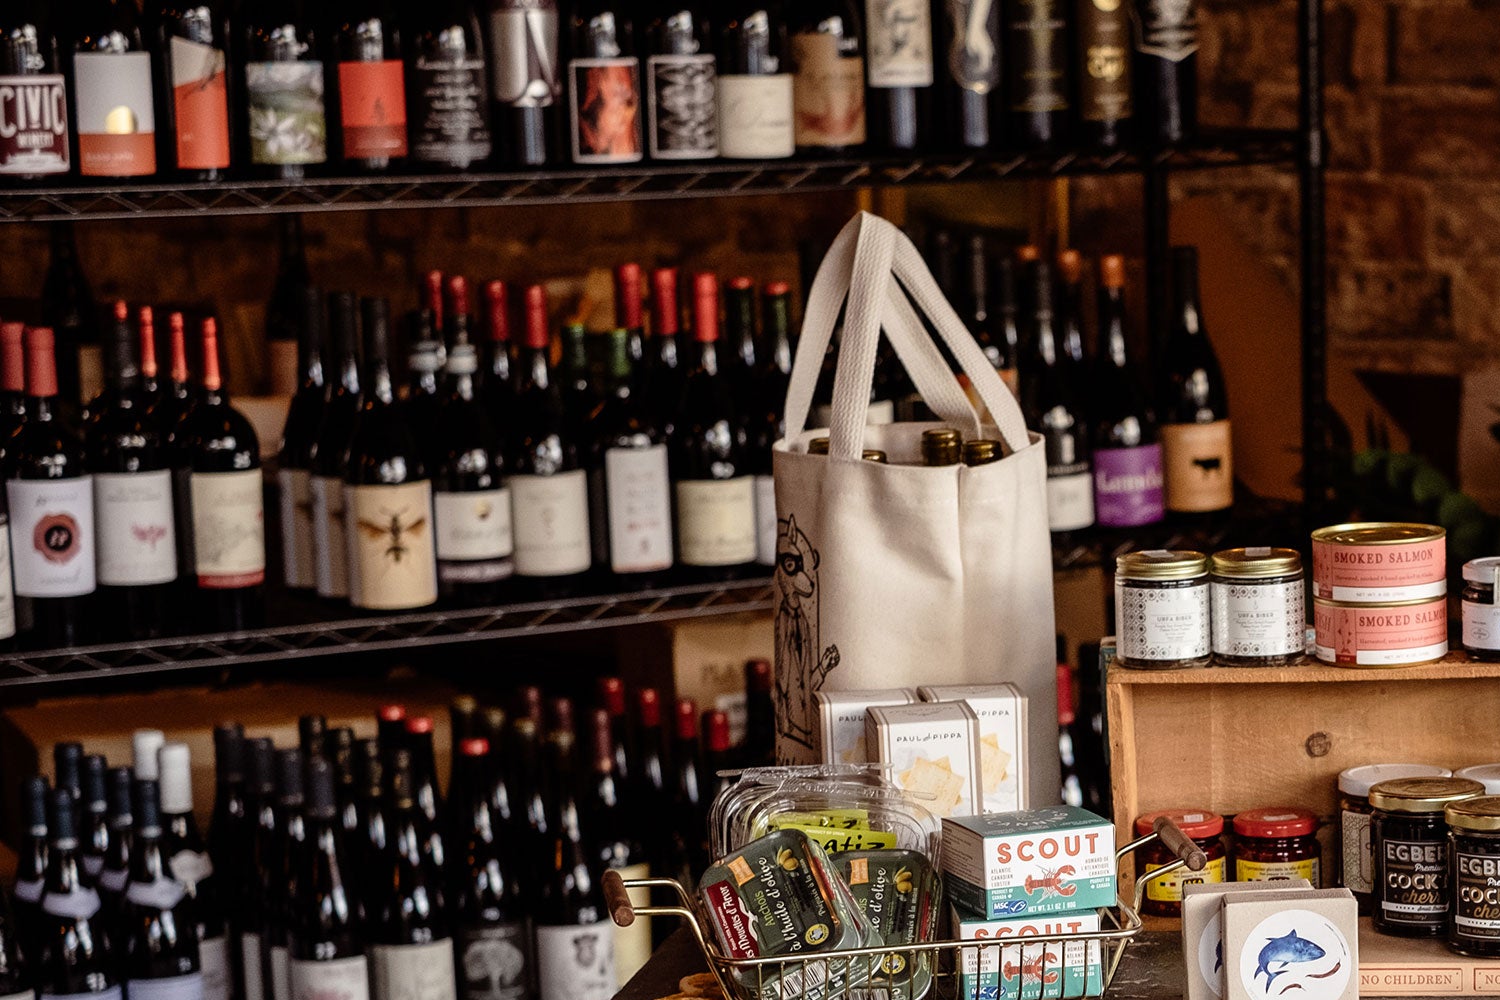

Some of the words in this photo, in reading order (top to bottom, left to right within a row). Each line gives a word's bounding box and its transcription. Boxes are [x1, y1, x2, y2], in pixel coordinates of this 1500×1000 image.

[0, 86, 66, 139] CIVIC
[1334, 552, 1383, 564] SMOKED
[1389, 549, 1433, 563] SALMON
[1359, 615, 1410, 627] SMOKED
[1415, 608, 1446, 620] SALMO
[838, 715, 864, 723] PAUL
[932, 732, 962, 740] PIPPA
[815, 834, 886, 851] atiz
[997, 833, 1098, 864] SCOUT
[758, 857, 781, 898] d'olive
[1387, 873, 1440, 891] COCK
[873, 866, 889, 909] d'olive
[755, 890, 775, 927] Anchois
[993, 901, 1008, 910] MSC
[974, 922, 1082, 949] SCOUT
[1361, 974, 1379, 985] NO
[1384, 974, 1453, 985] CHILDREN
